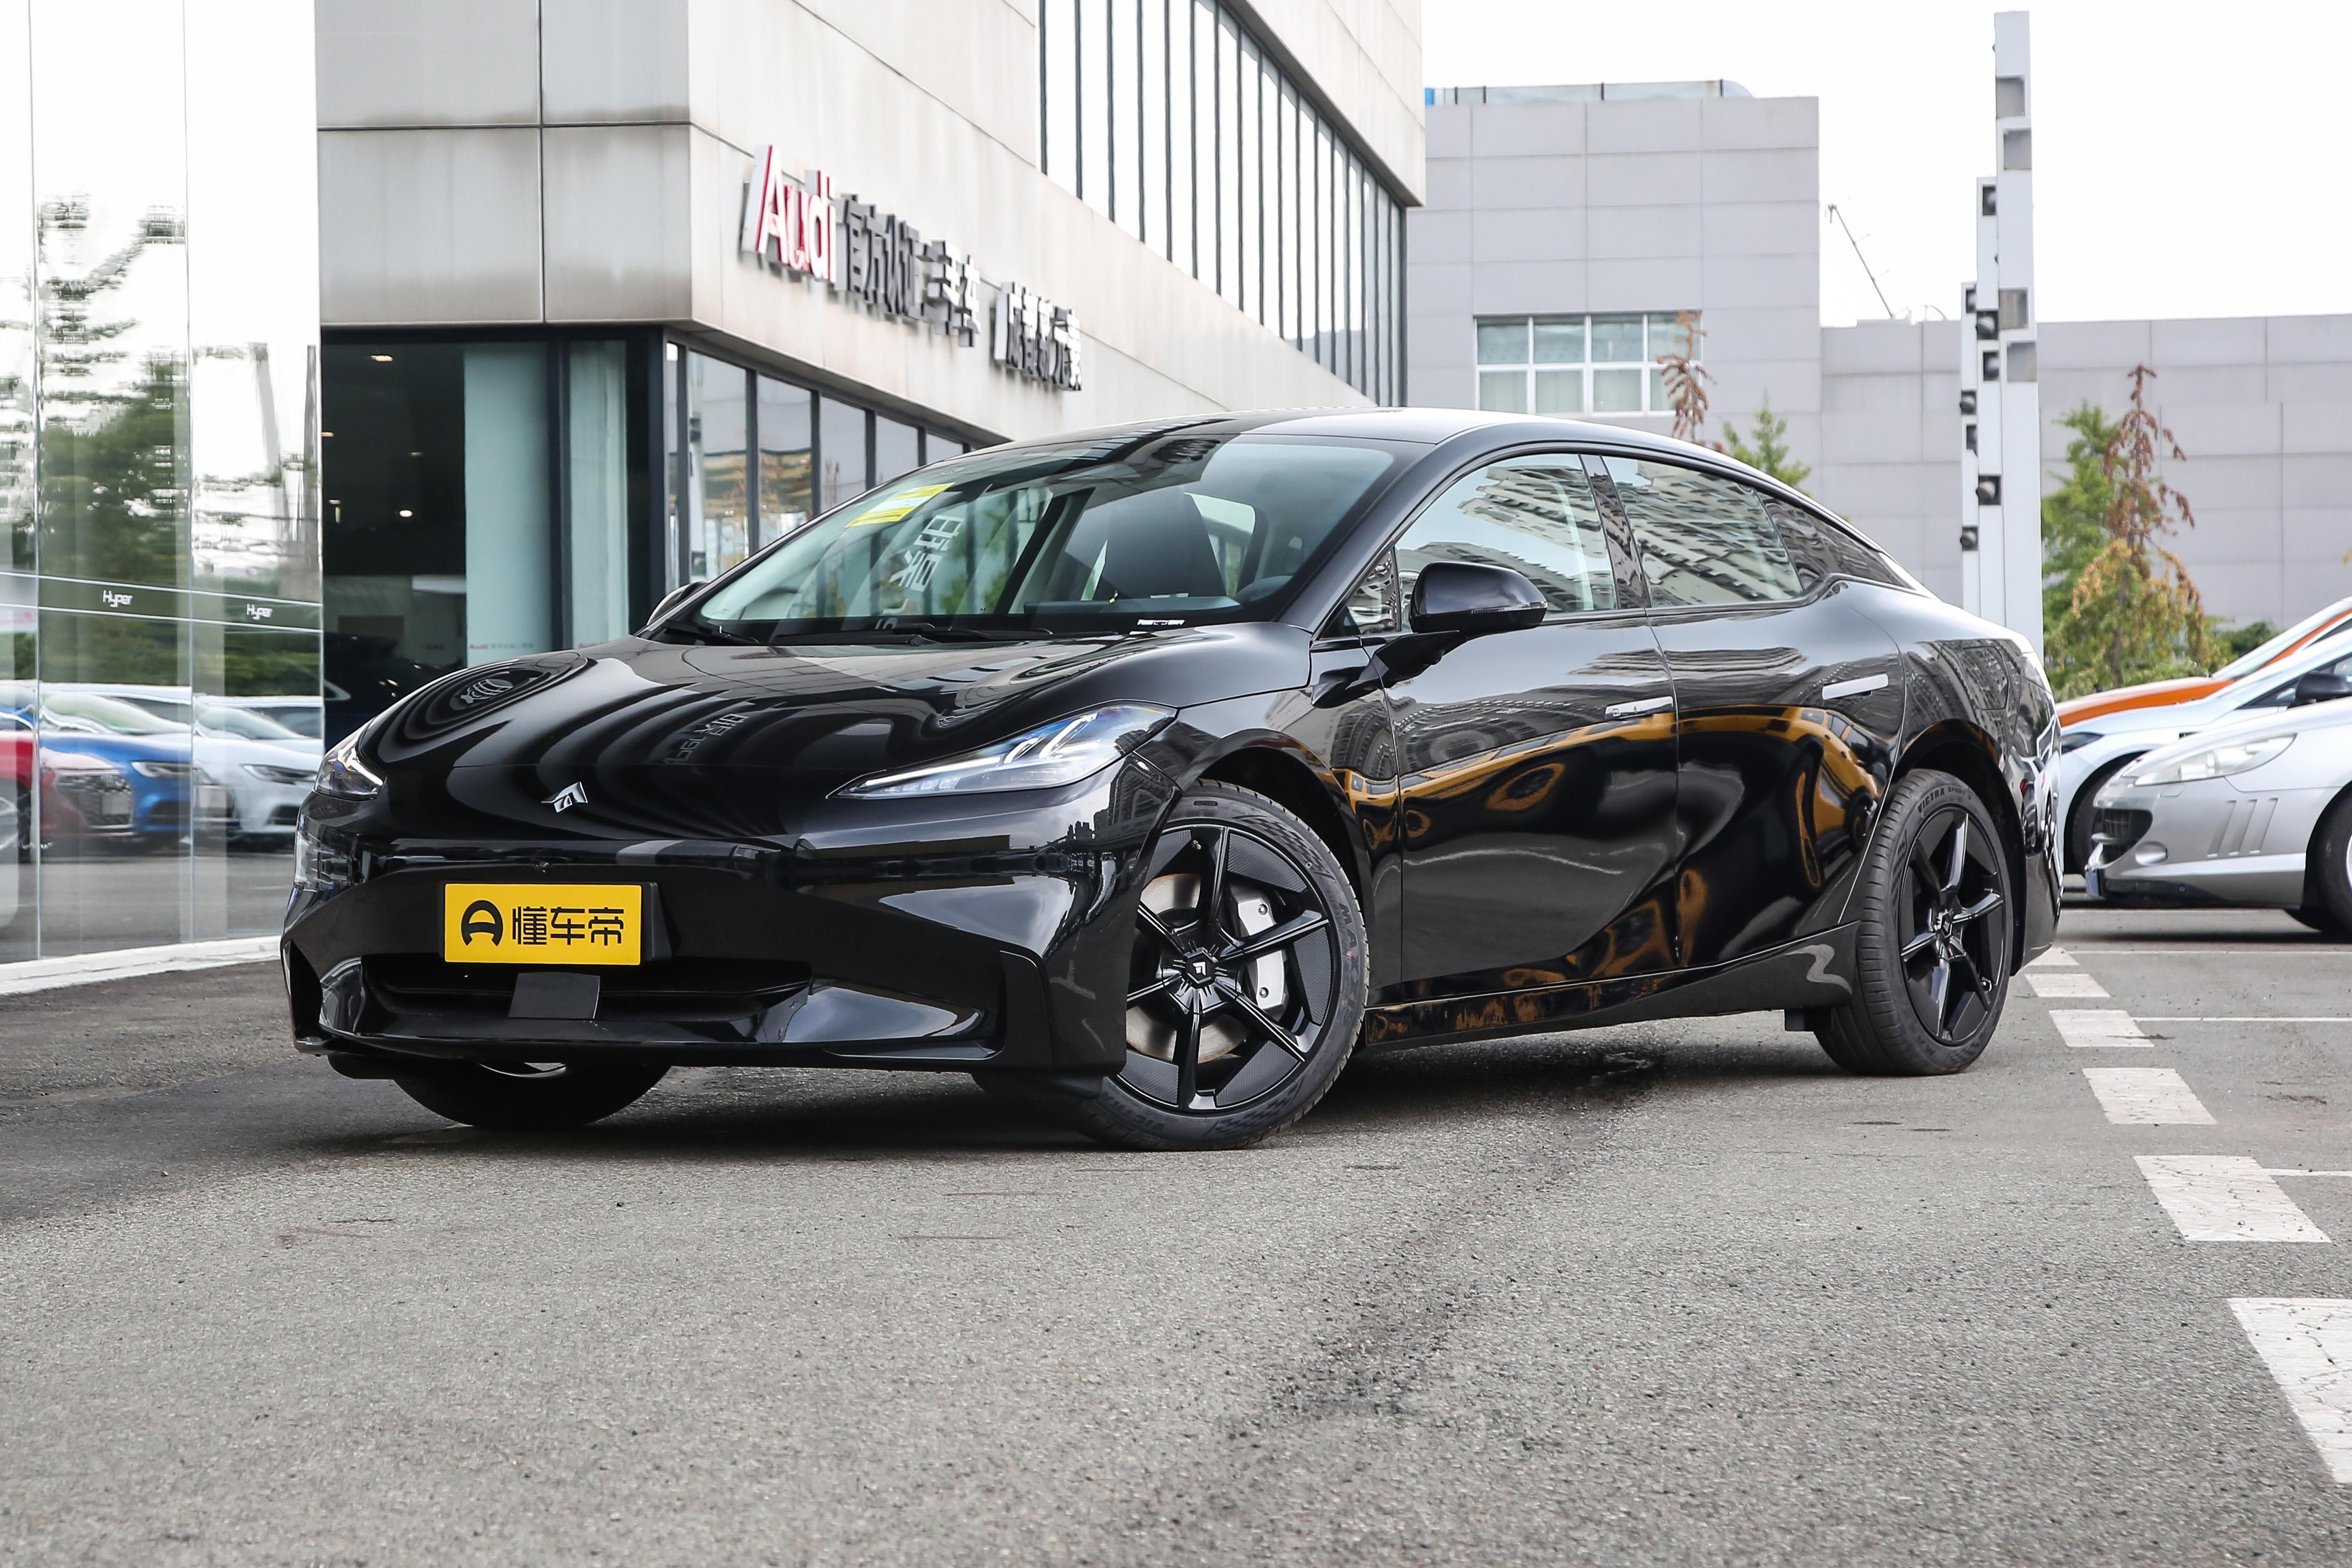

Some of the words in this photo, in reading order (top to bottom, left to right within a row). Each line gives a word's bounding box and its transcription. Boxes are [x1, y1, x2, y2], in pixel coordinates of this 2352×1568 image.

[742, 144, 837, 283] Audi
[102, 590, 133, 607] Hyper
[246, 603, 273, 621] Hyper
[1917, 787, 1945, 813] VICTRA
[512, 906, 624, 946] 懂车帝
